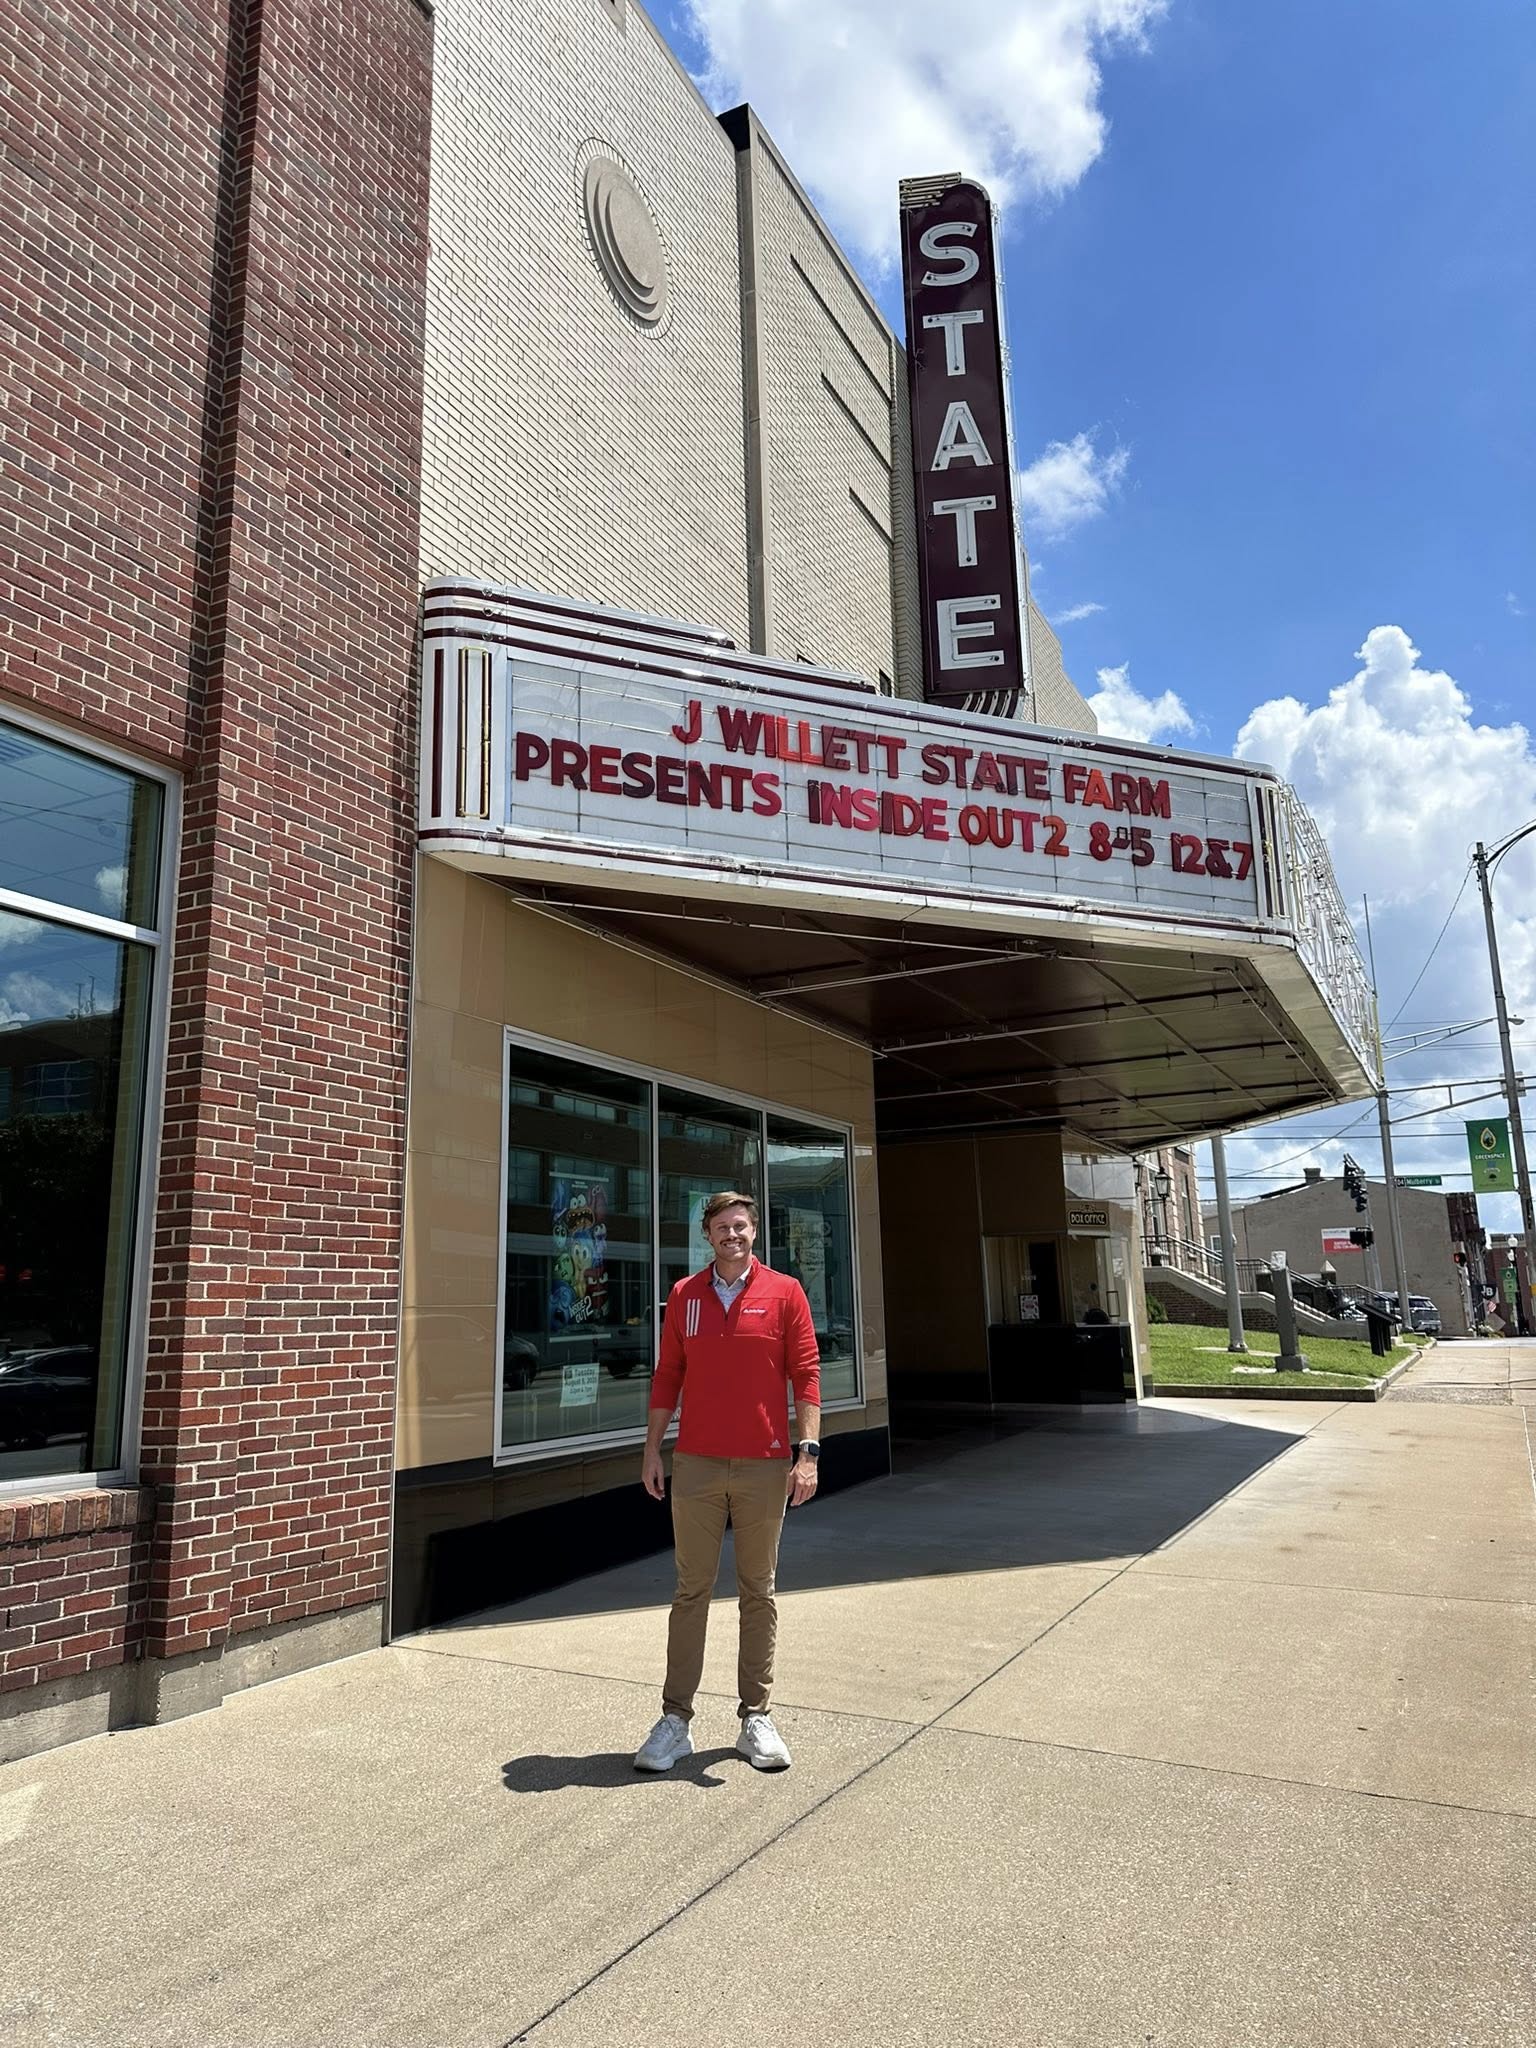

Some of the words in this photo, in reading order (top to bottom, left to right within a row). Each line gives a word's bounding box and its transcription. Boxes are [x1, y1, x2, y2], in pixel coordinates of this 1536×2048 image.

[919, 221, 1004, 670] STATE
[516, 731, 782, 817] PRESENTS
[808, 779, 949, 841] INSIDE
[672, 700, 702, 744] J
[717, 705, 907, 779] WILLETT
[921, 743, 1052, 801] STATE
[1063, 763, 1172, 819] FARM
[1071, 1213, 1084, 1223] BOX
[1084, 1213, 1105, 1225] OFFICE
[1481, 1285, 1494, 1296] JB
[575, 1368, 595, 1377] Tuesday
